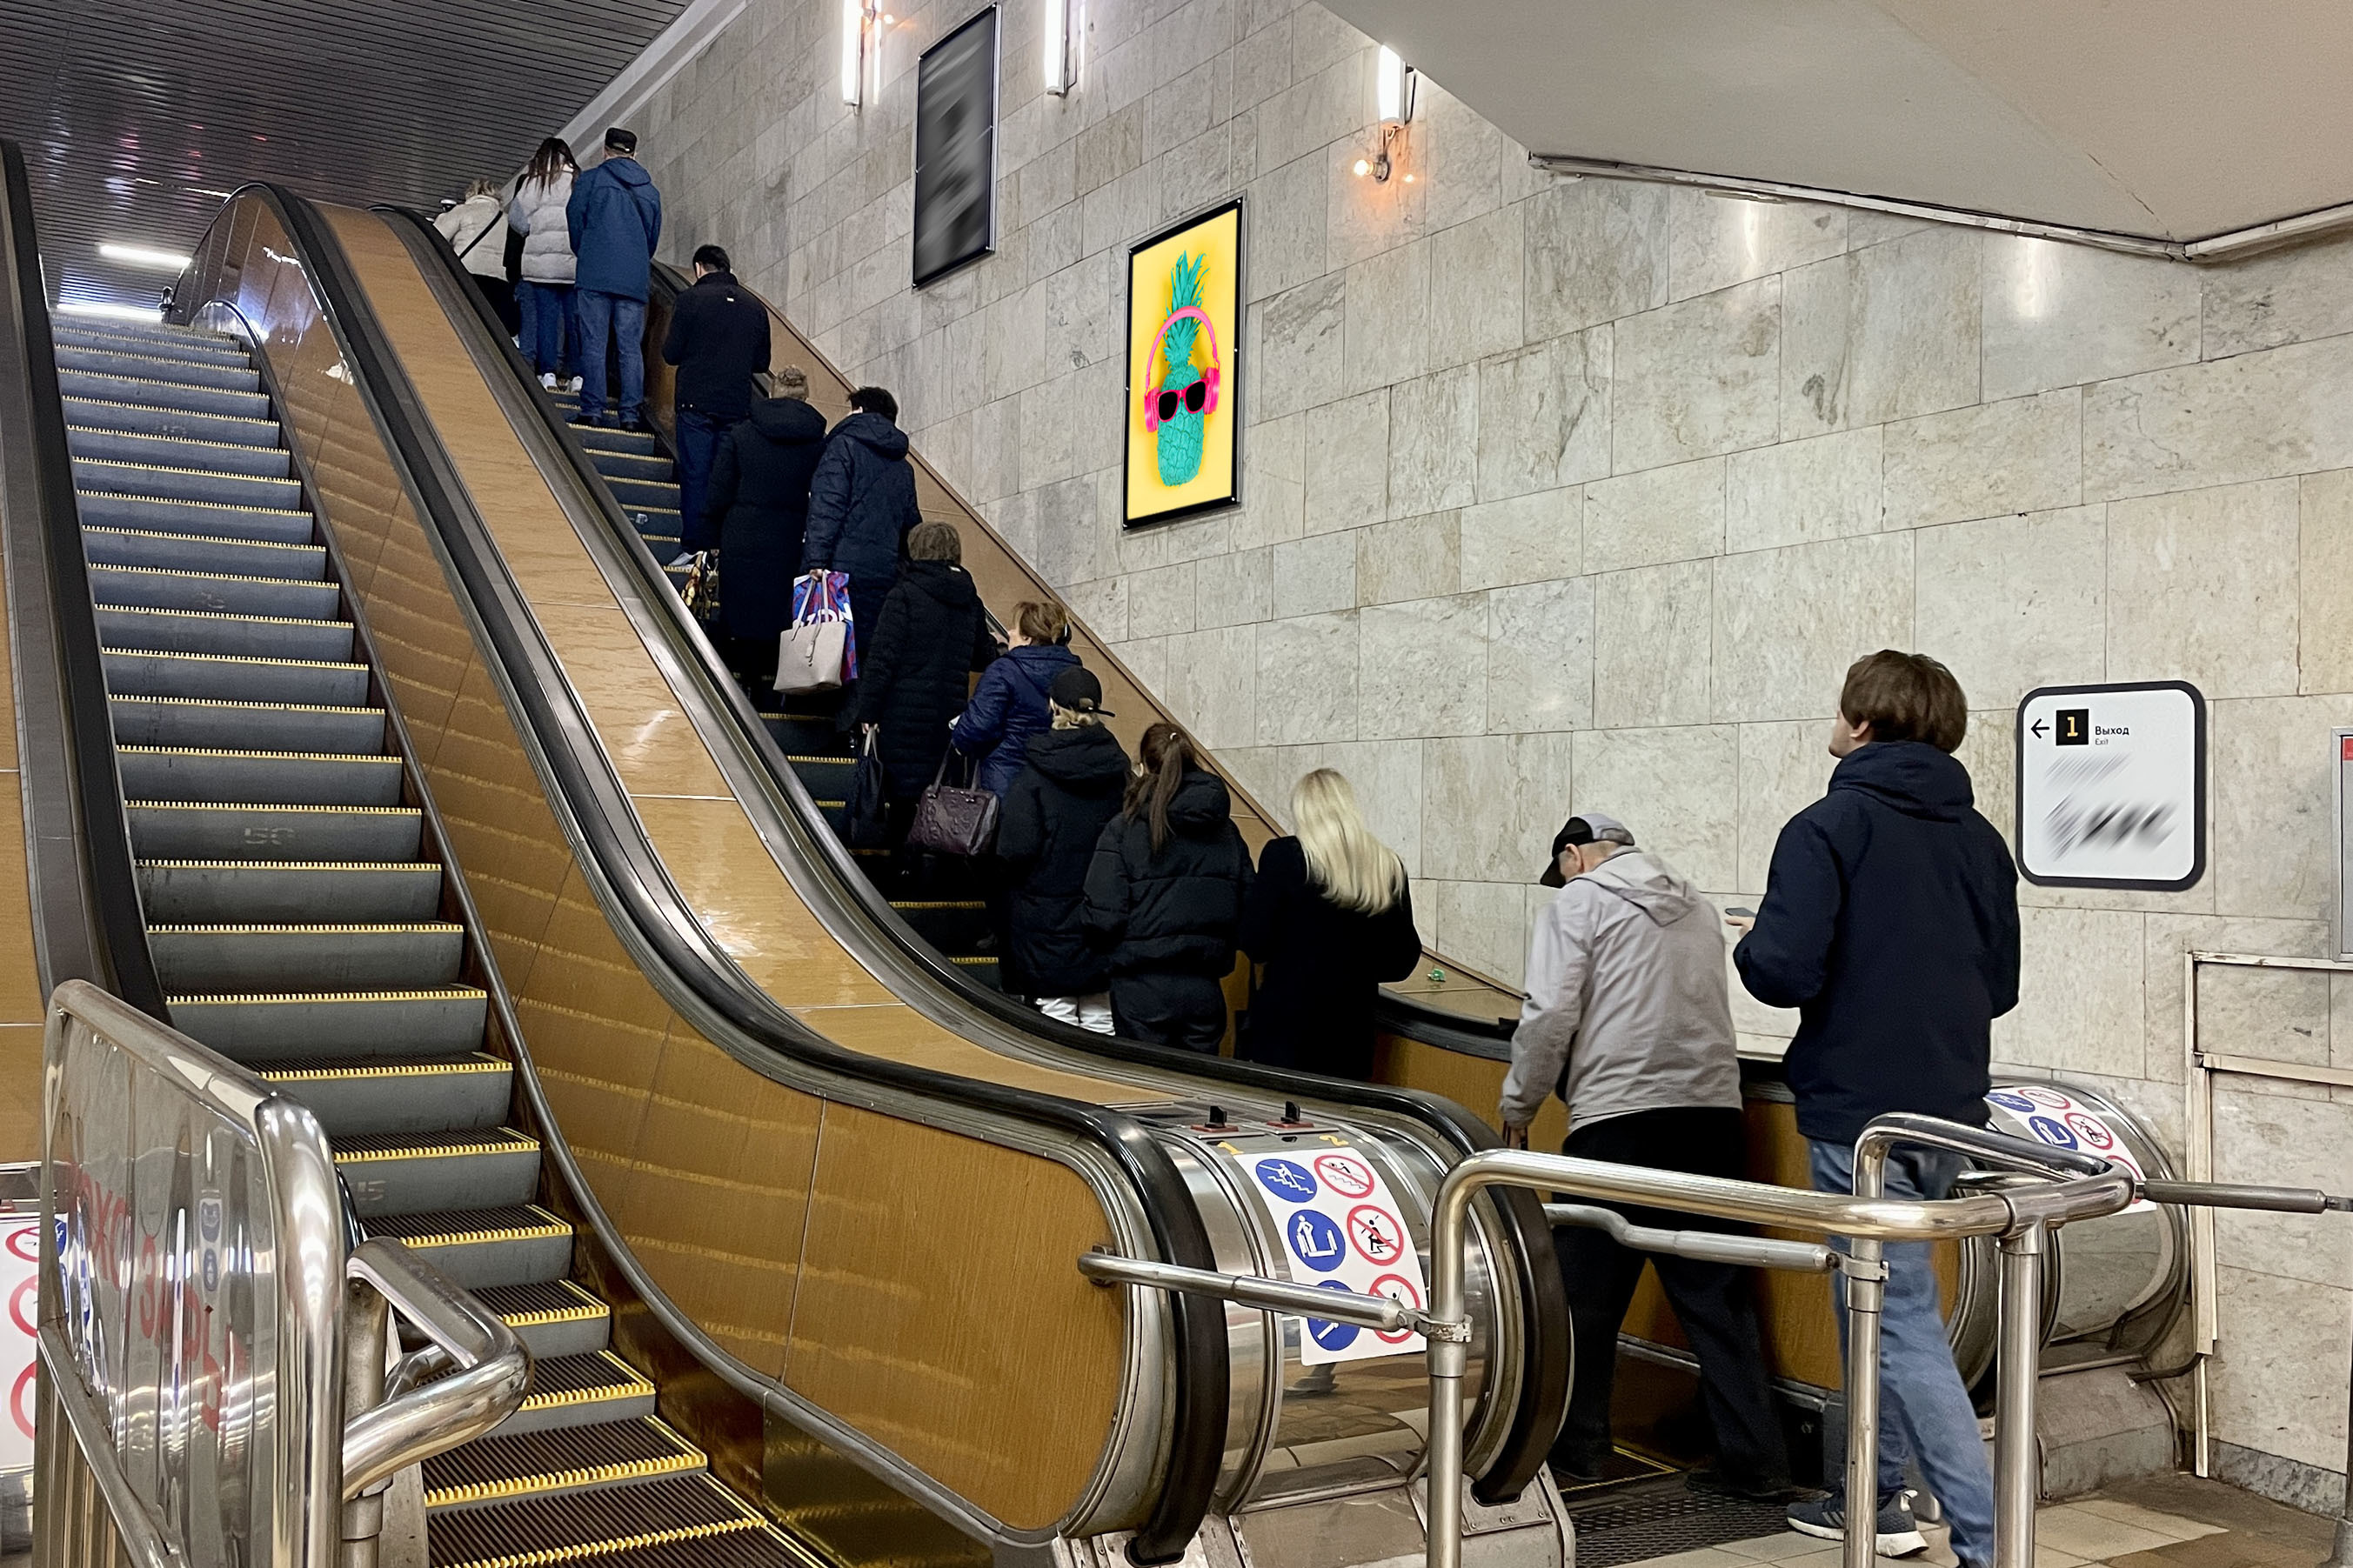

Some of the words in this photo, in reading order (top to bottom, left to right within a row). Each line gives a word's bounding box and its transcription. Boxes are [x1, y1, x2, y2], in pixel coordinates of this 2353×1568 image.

[2066, 717, 2079, 737] 1
[2095, 725, 2129, 736] Выход
[1319, 1134, 1349, 1147] 2
[1217, 1141, 1244, 1156] 1
